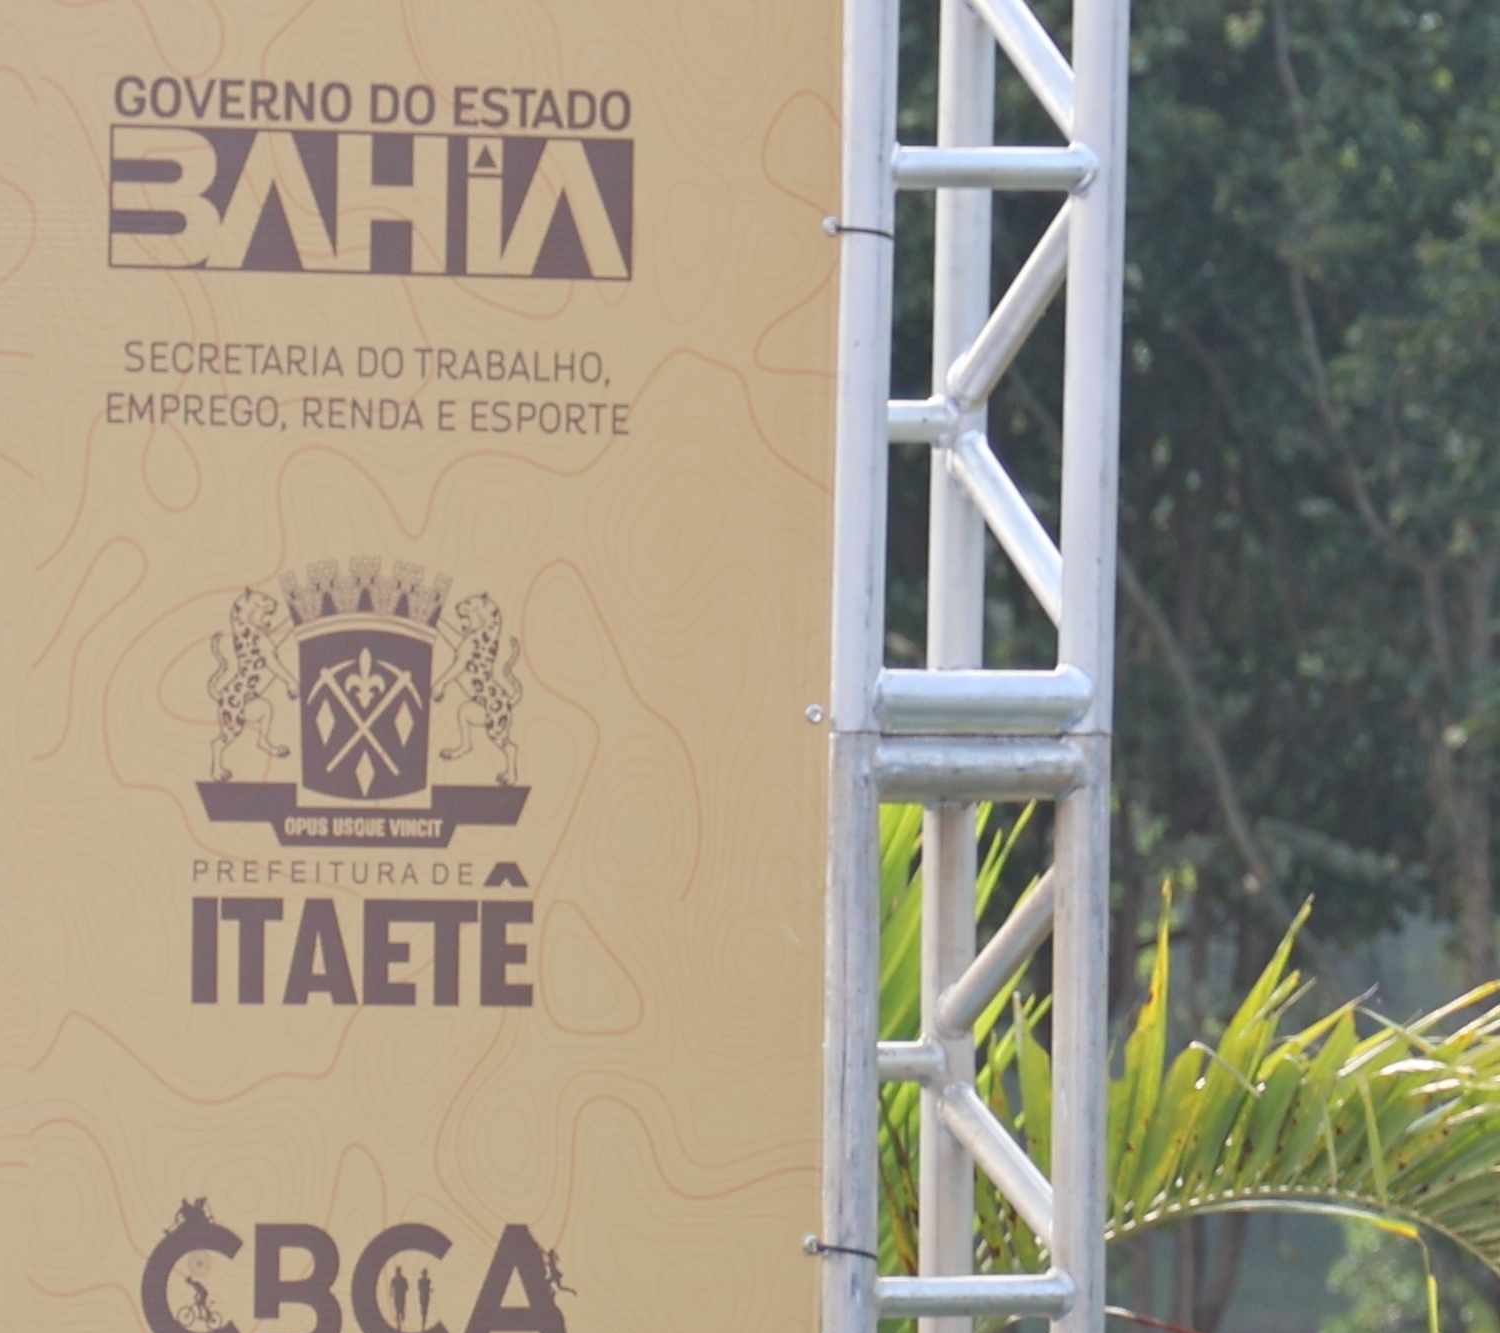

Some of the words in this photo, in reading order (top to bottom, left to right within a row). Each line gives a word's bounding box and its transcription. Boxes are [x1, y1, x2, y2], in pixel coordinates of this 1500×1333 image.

[114, 75, 353, 123] GOVERNO
[369, 84, 436, 126] DO
[453, 86, 632, 131] ESTADO
[111, 126, 632, 279] BAHIA
[123, 341, 345, 378] SECRETARIA
[357, 346, 404, 379] DO
[414, 347, 612, 387] TRABALHO,
[105, 392, 288, 431] EMPREGO,
[301, 396, 424, 431] RENDA
[437, 400, 456, 431] E
[470, 400, 630, 435] ESPORTE
[284, 816, 329, 837] OPUS
[332, 817, 386, 838] USQUE
[389, 818, 444, 838] VINCIT
[192, 859, 419, 885] PREFEITURA
[431, 863, 474, 886] DE
[191, 862, 534, 1006] ITAETÊ
